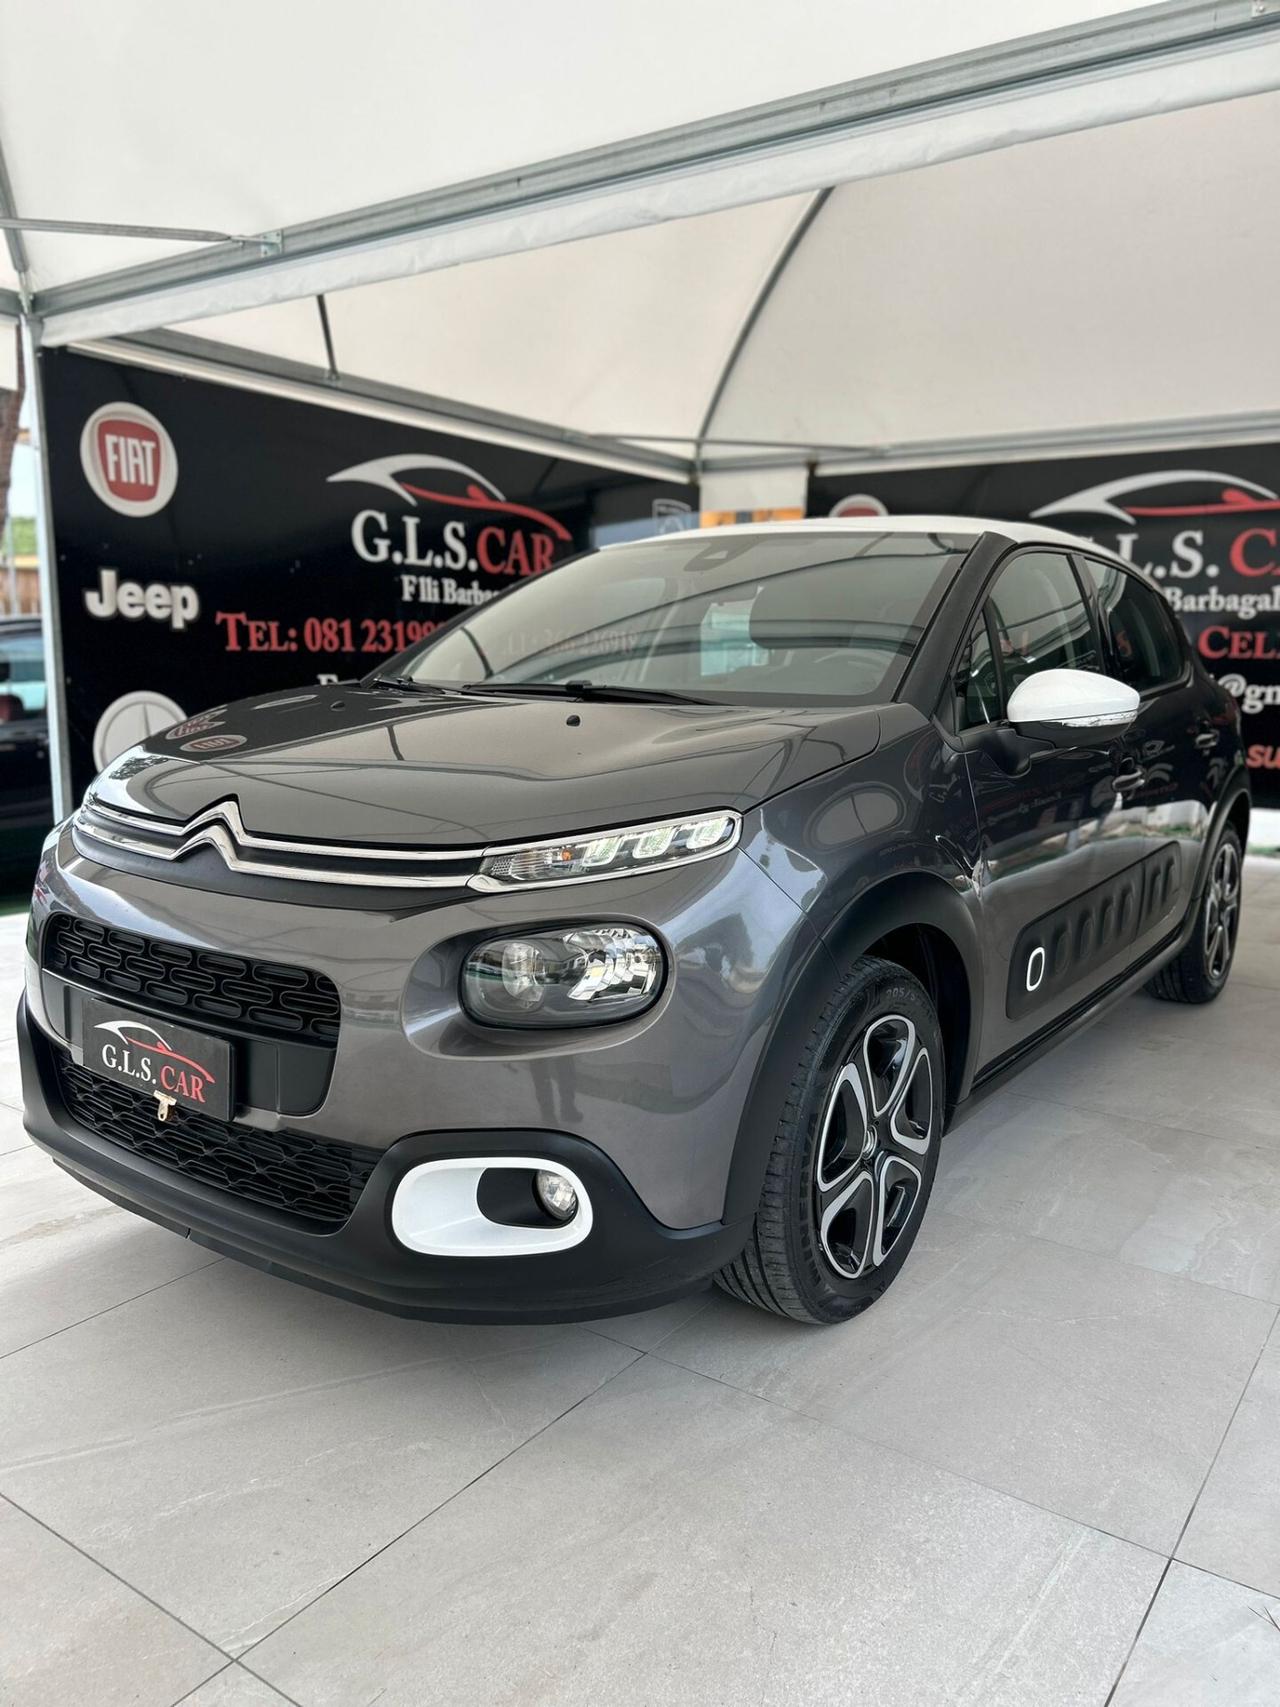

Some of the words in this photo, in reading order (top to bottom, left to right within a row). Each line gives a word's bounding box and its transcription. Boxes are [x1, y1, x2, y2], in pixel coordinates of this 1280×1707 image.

[105, 434, 157, 486] FIAT
[476, 525, 555, 576] CAR
[1229, 528, 1280, 577] C
[84, 568, 200, 630] Jeep
[303, 617, 355, 652] 081
[101, 1043, 157, 1085] G.L.S.
[160, 1065, 206, 1104] CAR
